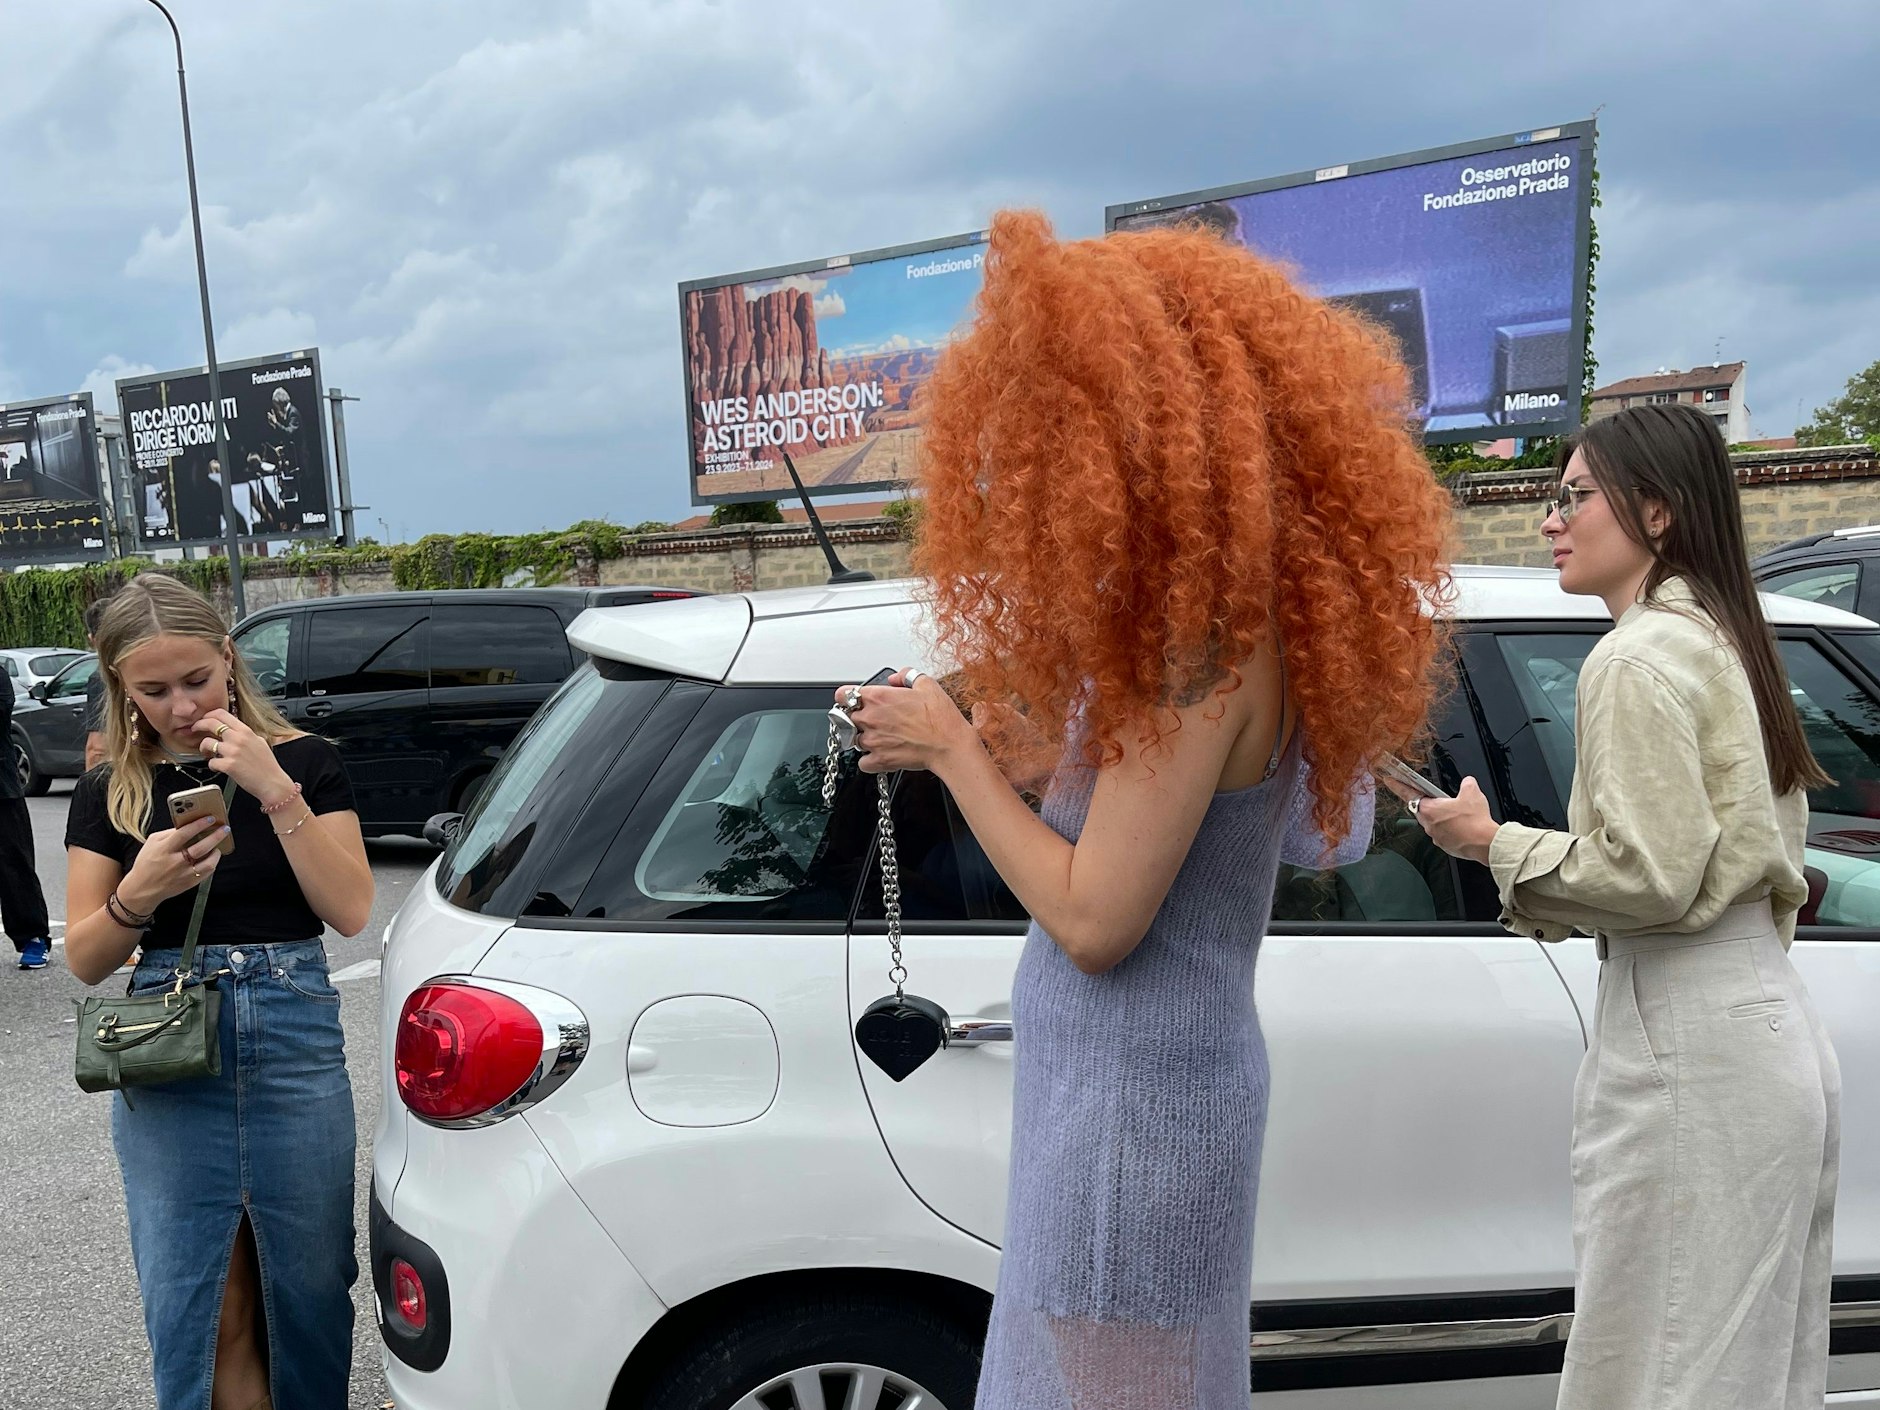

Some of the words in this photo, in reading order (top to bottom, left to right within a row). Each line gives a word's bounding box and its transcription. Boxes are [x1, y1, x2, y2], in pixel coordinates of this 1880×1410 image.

[1461, 153, 1570, 186] Osservatorio
[1423, 185, 1517, 211] Fondazione
[1519, 173, 1569, 196] Prada
[906, 259, 971, 279] Fondazione
[252, 370, 289, 385] Fondazione
[290, 365, 312, 379] Prada
[701, 397, 749, 426] WES
[753, 381, 884, 421] ANDERSON:
[1504, 393, 1560, 411] Milano
[130, 403, 201, 431] RICCARDO
[133, 427, 177, 452] DIRIGE
[704, 418, 808, 452] ASTEROID
[812, 410, 865, 441] CITY
[705, 451, 750, 464] EXHIBITION
[303, 512, 326, 524] Milano
